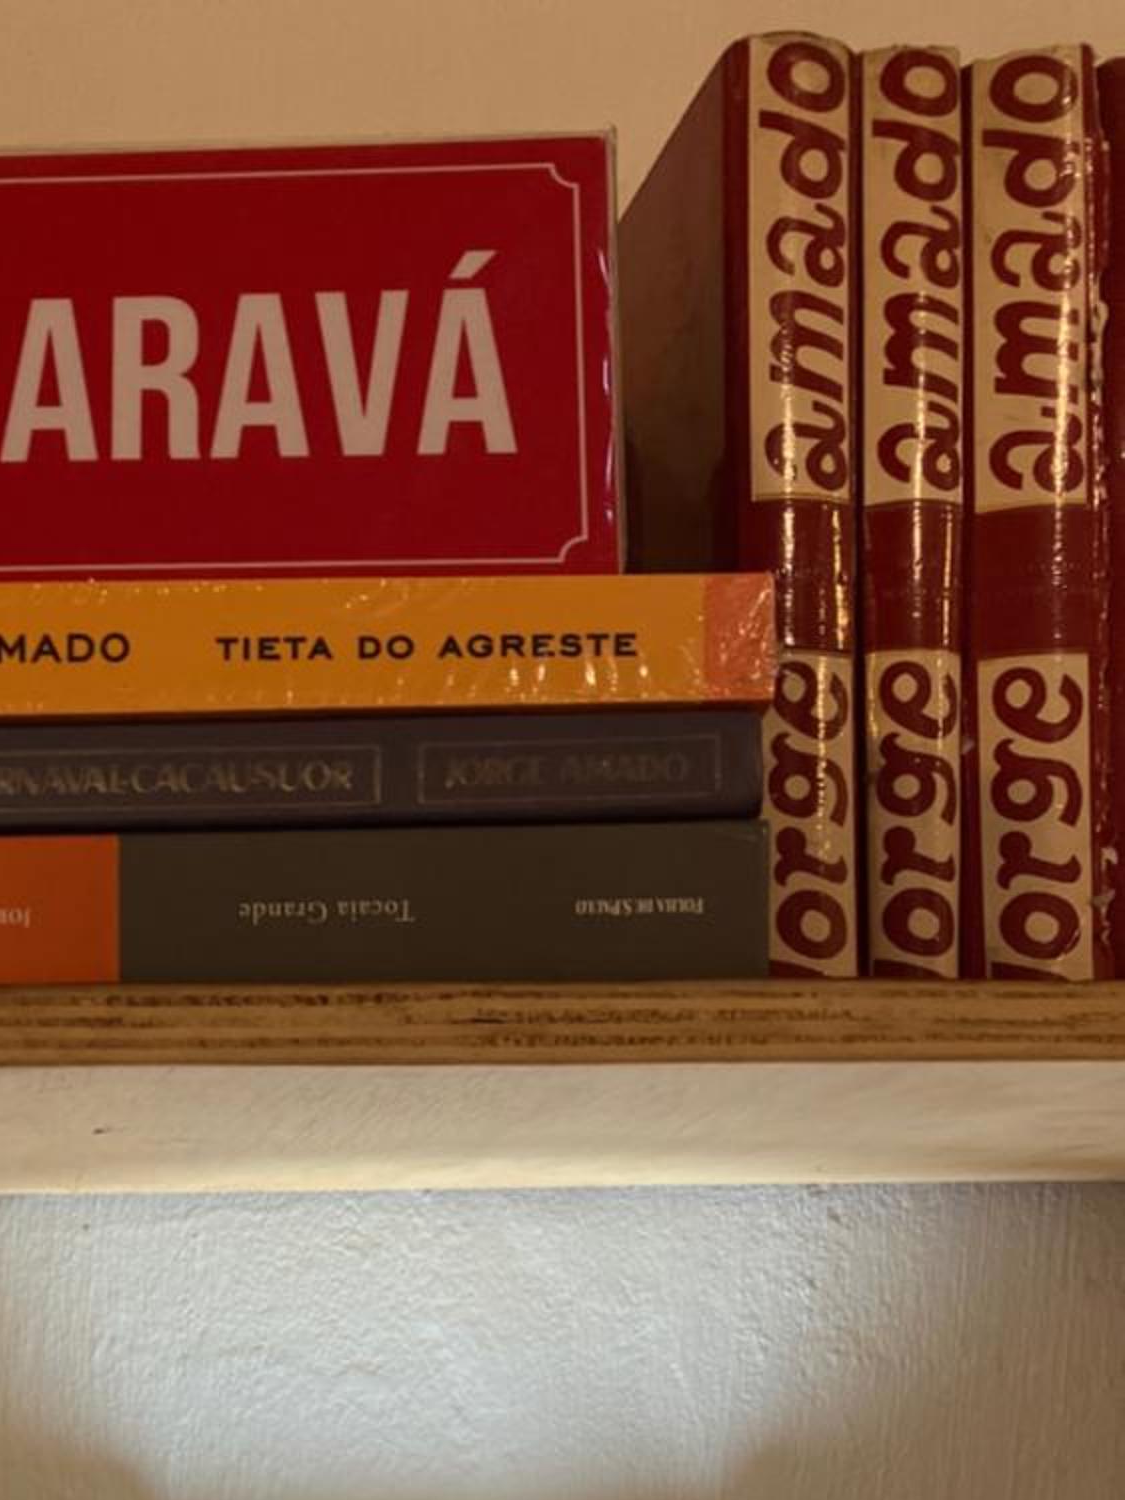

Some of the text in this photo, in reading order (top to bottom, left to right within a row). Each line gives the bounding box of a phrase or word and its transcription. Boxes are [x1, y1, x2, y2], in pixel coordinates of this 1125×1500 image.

[216, 632, 639, 662] TIETA DO AGRESTE
[238, 898, 416, 927] Tocaia Grande
[759, 42, 847, 977] orge amado
[872, 50, 960, 978] orge amado
[982, 55, 1084, 981] orge amado
